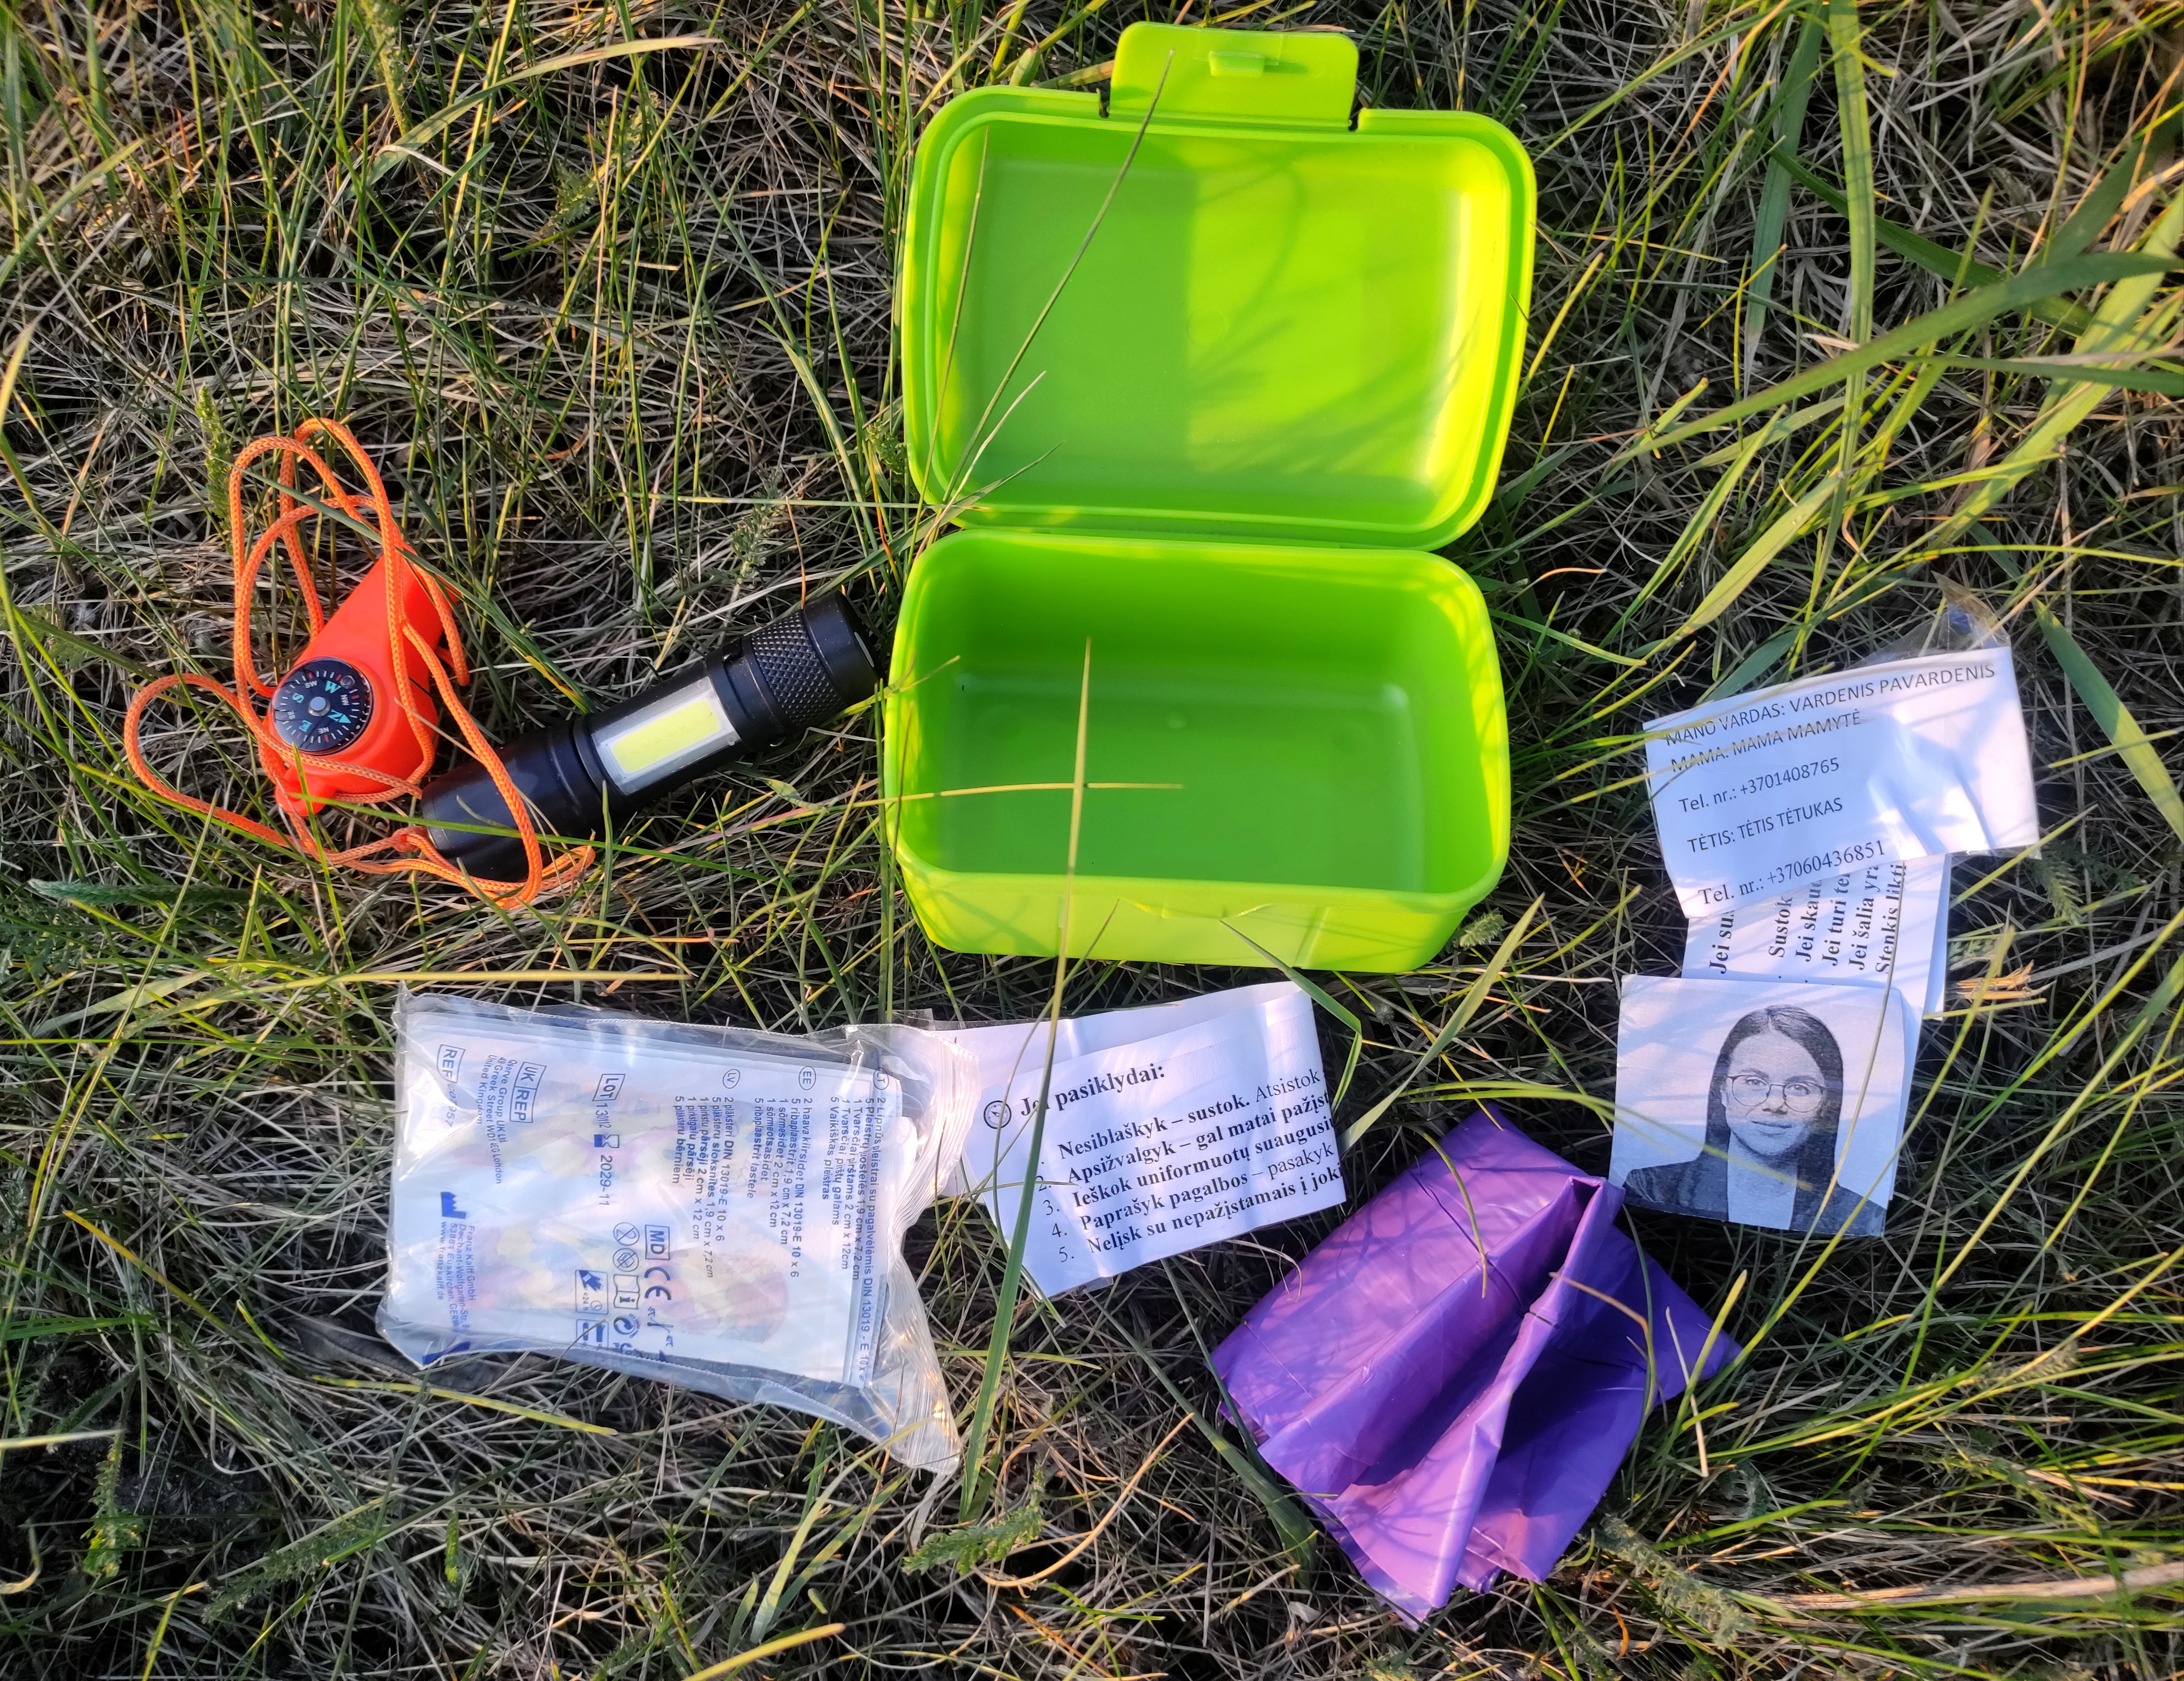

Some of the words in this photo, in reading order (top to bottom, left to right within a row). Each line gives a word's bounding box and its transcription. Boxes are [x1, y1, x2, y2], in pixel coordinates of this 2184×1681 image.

[292, 692, 305, 703] S
[305, 680, 318, 688] SW
[324, 680, 341, 694] W
[1719, 703, 1785, 731] VARDAS:
[1789, 682, 1874, 713] VARDENIS
[1880, 664, 1995, 693] PAVARDENIS
[340, 694, 350, 706] NW
[288, 710, 296, 720] SE
[298, 719, 313, 733] E
[318, 726, 330, 734] NE
[1732, 730, 1784, 756] MAMA
[1787, 708, 1861, 741] MAMYTĖ
[1678, 794, 1709, 813] Tel.
[1713, 788, 1737, 805] nr.:
[1740, 757, 1840, 795] +3701408765
[1687, 830, 1736, 853] TĖTIS:
[1737, 816, 1774, 840] TĖTIS
[1776, 797, 1843, 827] TĖTUKAS
[1698, 884, 1735, 905] Tel.
[1740, 877, 1764, 896] nr.:
[1767, 839, 1885, 886] +37060436851
[1768, 896, 1794, 958] Sustok
[1828, 899, 1847, 933] turi
[1852, 897, 1875, 940] šalia
[1795, 935, 1815, 963] Jei
[1821, 939, 1841, 966] Jei
[1875, 906, 1899, 975] Stenkis
[1709, 944, 1730, 975] Jei
[1848, 943, 1868, 971] Jei
[442, 1048, 458, 1079] REF
[480, 1054, 498, 1079] United
[500, 1059, 518, 1085] Qserve
[519, 1066, 539, 1083] UK
[725, 1072, 737, 1083] LV
[488, 1065, 503, 1092] Greek
[599, 1077, 620, 1099] LOT
[802, 1071, 812, 1085] EE
[1055, 1063, 1165, 1111] pasiklydai:
[486, 1094, 496, 1123] Street
[494, 1086, 508, 1118] Group
[514, 1089, 530, 1121] REP
[1058, 1117, 1169, 1160] Nesiblaškyk
[1187, 1094, 1250, 1123] sustok.
[1256, 1068, 1321, 1102] Atsistok
[496, 1119, 506, 1133] UK
[710, 1104, 722, 1140] plāksteru
[722, 1104, 735, 1138] plāksteri
[751, 1106, 764, 1160] ribaplaastrit
[775, 1106, 787, 1159] sõrmesidet
[801, 1107, 813, 1135] haava
[827, 1105, 840, 1156] Vaikiškas
[838, 1107, 851, 1155] Tvarsčiai
[849, 1107, 862, 1156] Tvarsčiai
[874, 1107, 885, 1145] Lipnūs
[696, 1129, 708, 1166] pārsēji
[723, 1140, 735, 1161] DIN
[788, 1107, 801, 1166] ribaplaastrit
[1069, 1141, 1177, 1184] Apsižvalgyk
[1196, 1126, 1225, 1151] gal
[1227, 1107, 1277, 1137] matai
[492, 1153, 502, 1185] London
[672, 1138, 683, 1184] bērniem
[683, 1142, 697, 1181] pārsēji
[707, 1142, 721, 1199] sloksnītes
[795, 1138, 810, 1181] kiirsidet
[870, 1146, 882, 1186] pleistrai
[598, 1154, 613, 1206] 2029-11
[694, 1177, 704, 1194] cm
[718, 1163, 731, 1206] 13019-E
[747, 1162, 759, 1199] lastele
[771, 1172, 780, 1189] cm
[783, 1168, 794, 1185] 1,9
[822, 1159, 834, 1200] pleistras
[845, 1157, 857, 1200] pirštams
[1042, 1199, 1060, 1216] 3.
[1071, 1177, 1133, 1208] Ieškok
[1136, 1146, 1251, 1187] uniformuotų
[1052, 1222, 1067, 1238] 4.
[1079, 1194, 1166, 1231] Paprašyk
[1169, 1172, 1248, 1209] pagalbos
[1267, 1142, 1335, 1180] pasakyk
[782, 1187, 790, 1200] cm
[795, 1183, 805, 1199] DIN
[868, 1188, 877, 1202] su
[692, 1208, 704, 1222] 12
[704, 1202, 716, 1217] 1,9
[717, 1208, 727, 1222] 10
[769, 1200, 780, 1213] 12
[780, 1211, 791, 1227] 7,2
[832, 1186, 842, 1226] galams
[1059, 1245, 1075, 1263] 5.
[1086, 1225, 1143, 1253] Nelįsk
[1146, 1222, 1168, 1237] su
[1171, 1182, 1296, 1228] nepažįstamais
[1300, 1176, 1308, 1195] į
[692, 1223, 701, 1239] cm
[703, 1220, 712, 1238] cm
[769, 1216, 778, 1228] cm
[792, 1201, 804, 1243] 13019-E
[844, 1213, 851, 1230] cm
[855, 1216, 863, 1234] cm
[466, 1225, 475, 1252] Franz
[649, 1230, 665, 1255] MD
[780, 1230, 788, 1245] cm
[466, 1253, 476, 1273] Kalff
[791, 1246, 801, 1258] 10
[644, 1266, 672, 1301] CE
[705, 1265, 714, 1279] cm
[790, 1270, 800, 1278] 6
[852, 1264, 861, 1281] cm
[466, 1275, 476, 1301] GmbH
[862, 1278, 873, 1297] DIN
[861, 1300, 872, 1332] 13019
